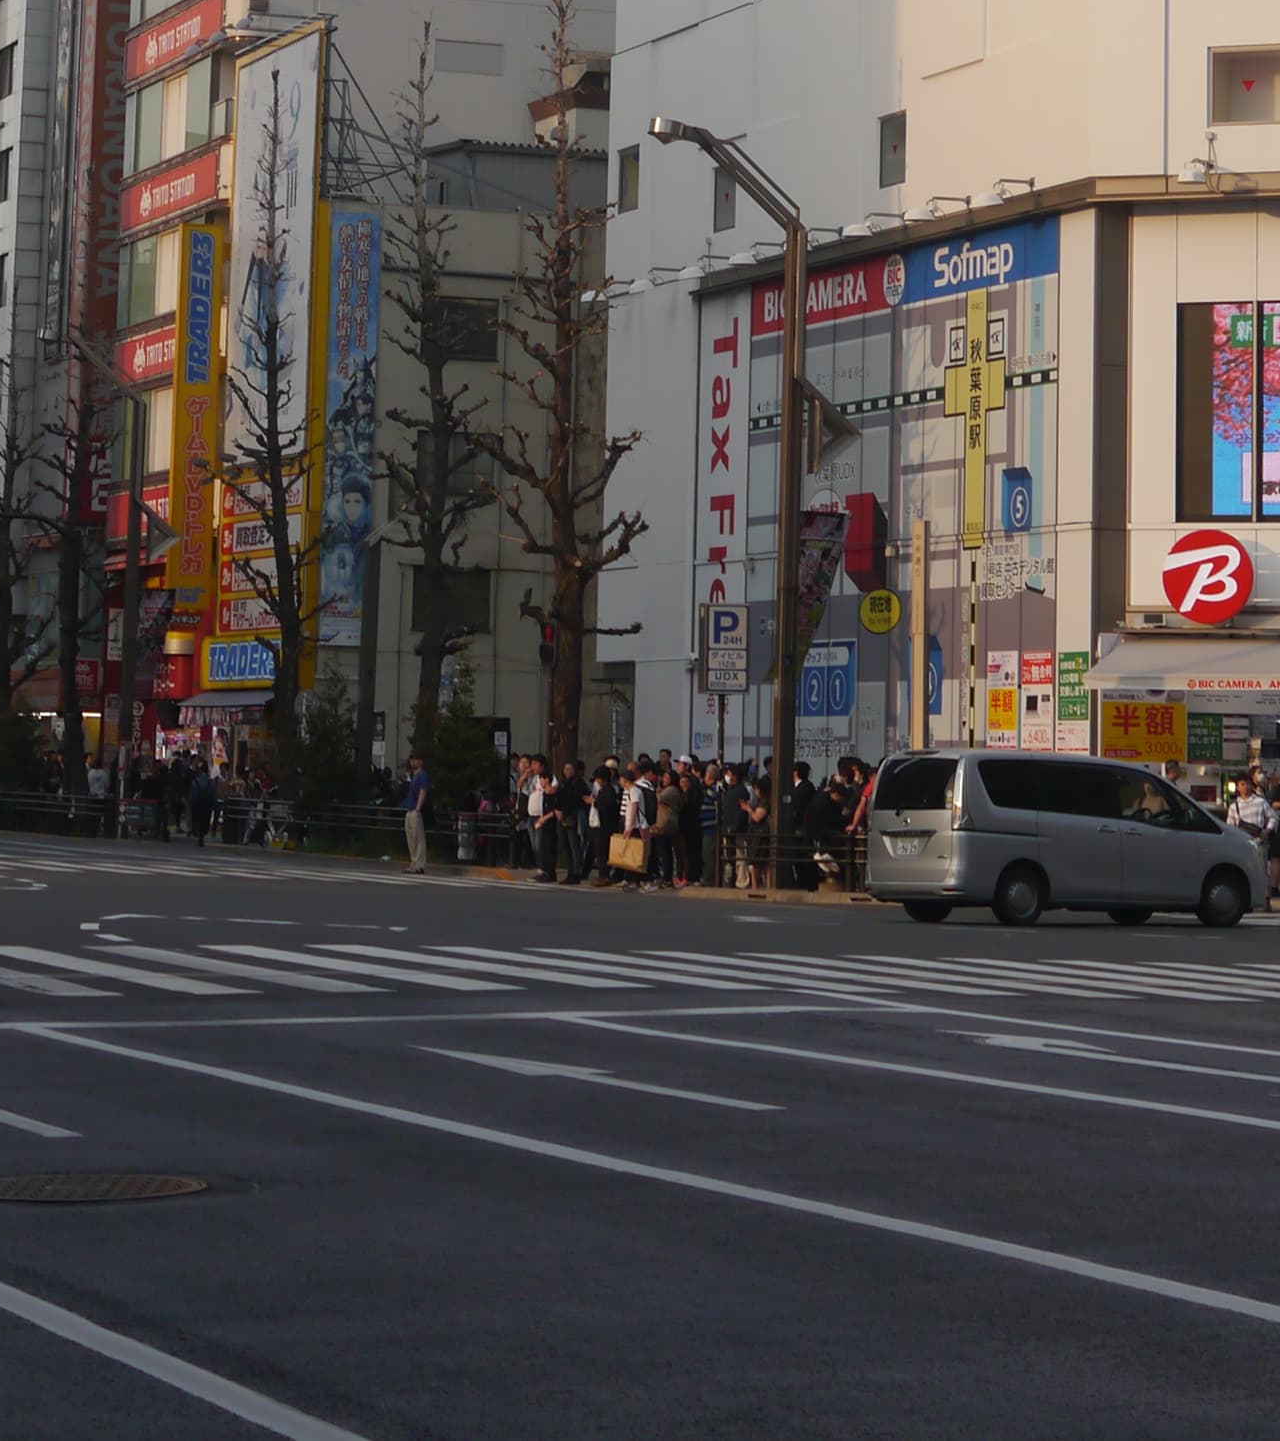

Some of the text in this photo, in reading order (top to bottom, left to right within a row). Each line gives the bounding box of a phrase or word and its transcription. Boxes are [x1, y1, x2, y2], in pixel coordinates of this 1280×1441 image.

[887, 266, 902, 283] BIC
[933, 241, 1014, 289] Sofmap
[710, 316, 739, 475] Tax
[969, 337, 983, 451] 秋葉原駅
[713, 610, 740, 645] P
[714, 672, 740, 681] UDX
[1198, 678, 1216, 689] BIC
[1218, 678, 1262, 689] CAMERA
[1111, 703, 1176, 737] 半額
